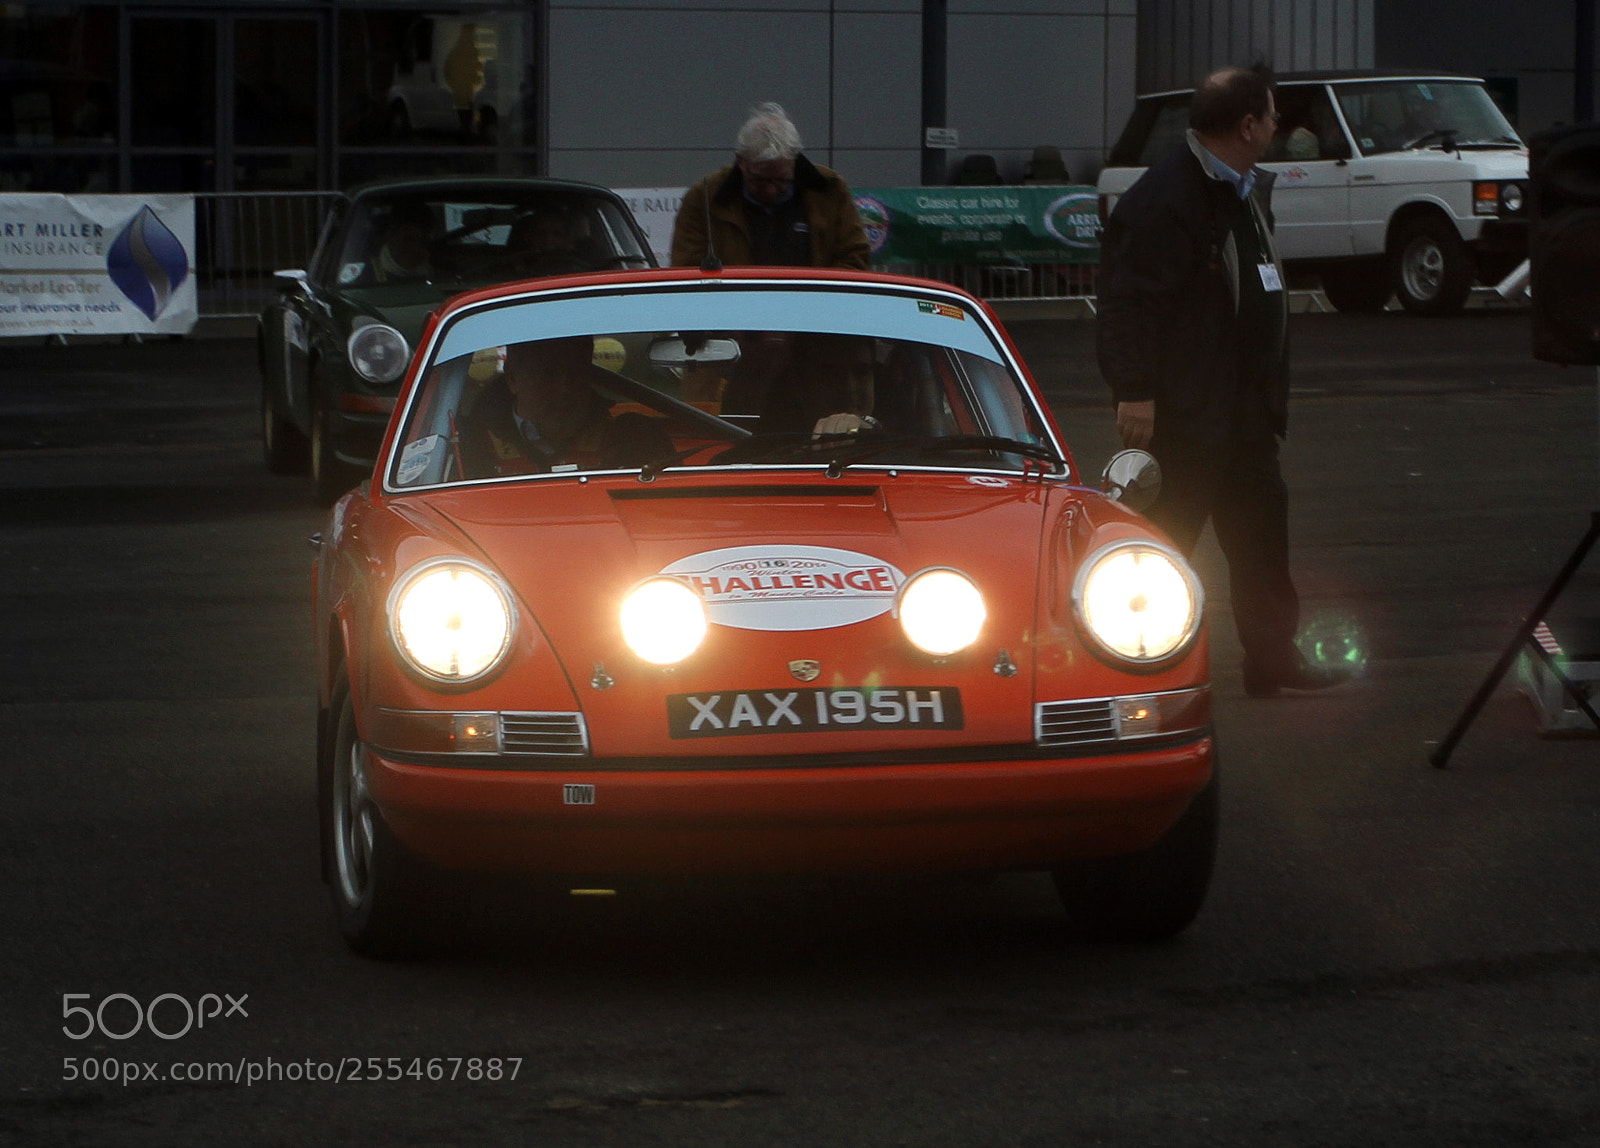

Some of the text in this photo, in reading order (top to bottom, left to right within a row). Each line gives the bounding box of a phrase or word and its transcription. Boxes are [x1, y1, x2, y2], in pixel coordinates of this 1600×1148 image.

[0, 222, 104, 237] RT MILLER
[4, 241, 106, 256] INSURANCE
[49, 278, 102, 295] Leader
[21, 301, 81, 313] insurance
[83, 301, 122, 313] needs
[687, 690, 945, 731] XAX 195H
[565, 785, 594, 804] TOW
